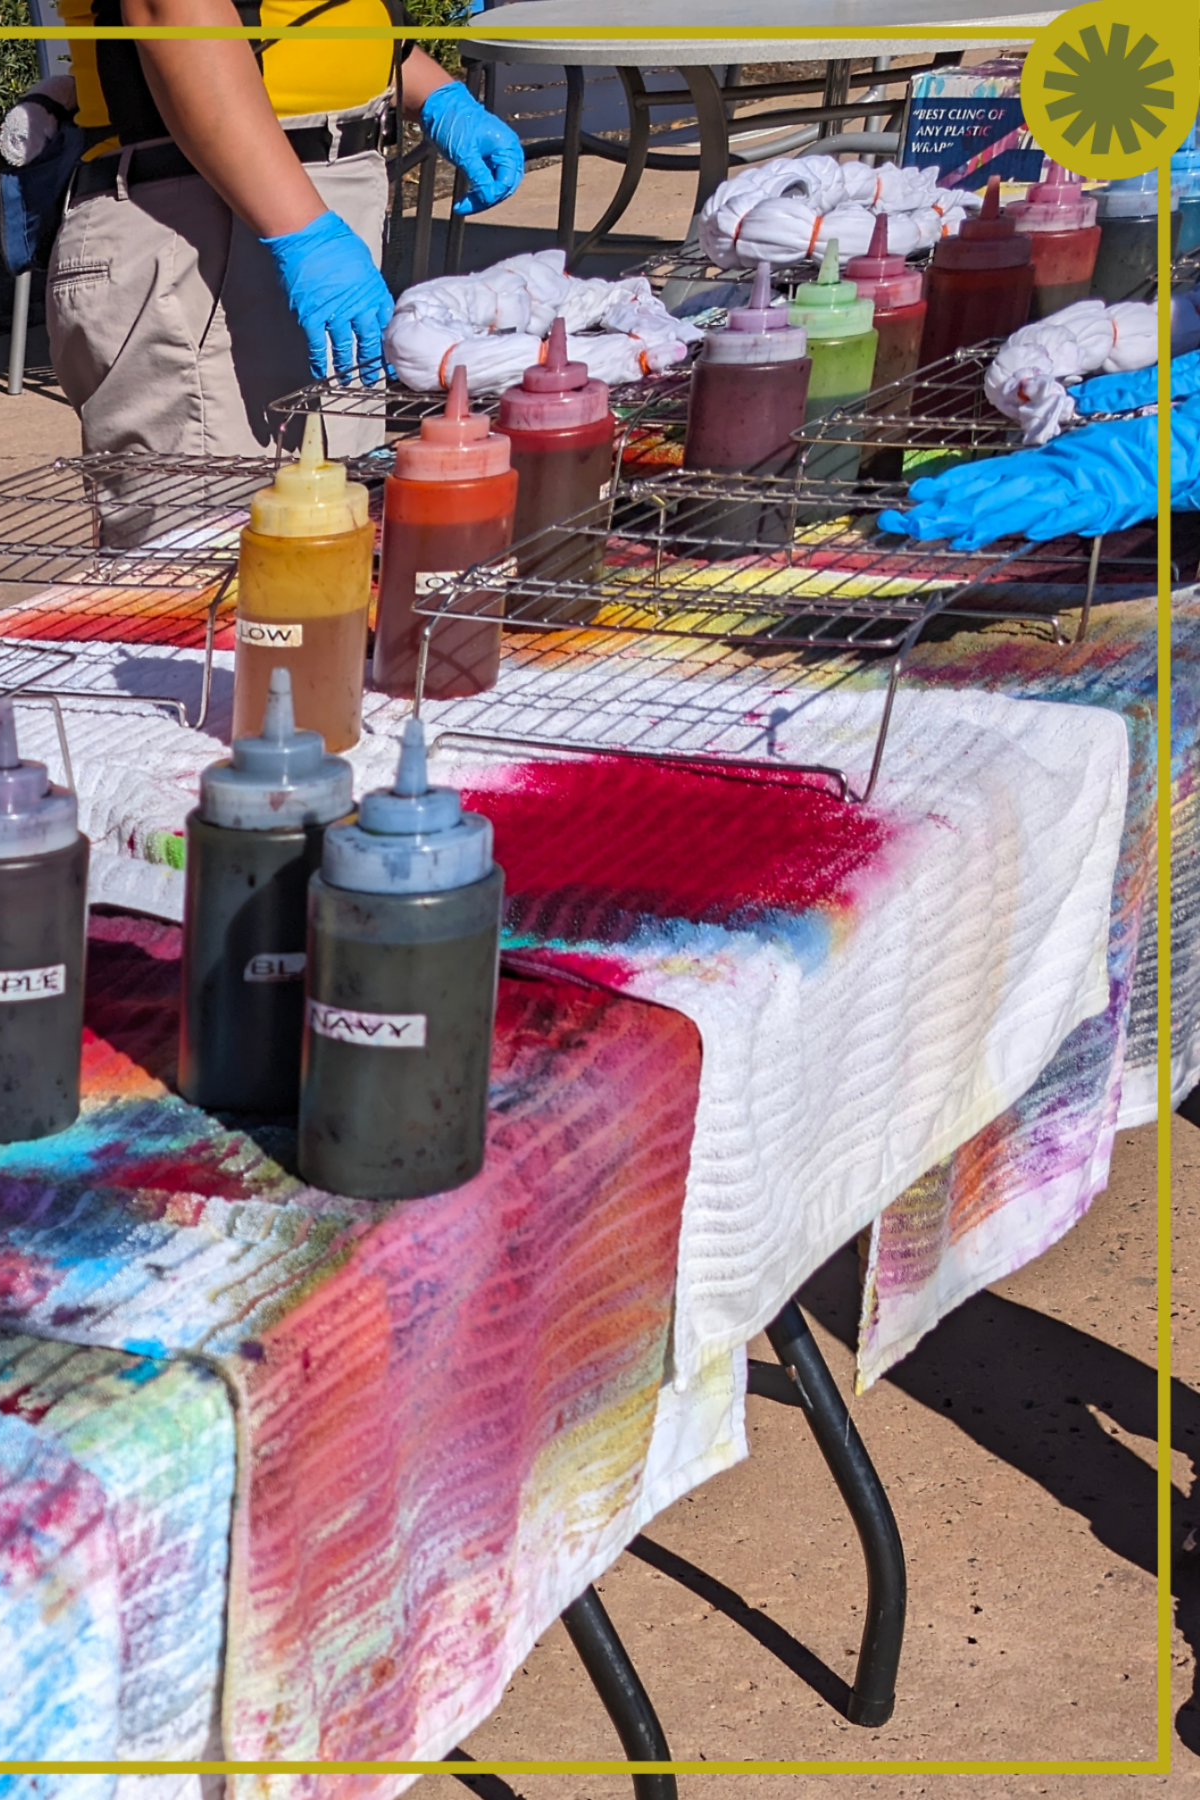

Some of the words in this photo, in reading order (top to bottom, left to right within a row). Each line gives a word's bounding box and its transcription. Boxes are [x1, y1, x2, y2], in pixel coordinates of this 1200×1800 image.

[948, 108, 986, 120] CLING
[988, 108, 1006, 120] OF
[915, 125, 943, 137] ANY
[943, 125, 992, 137] PLASTIC
[238, 623, 292, 641] LOW
[310, 1006, 412, 1038] NAVY
